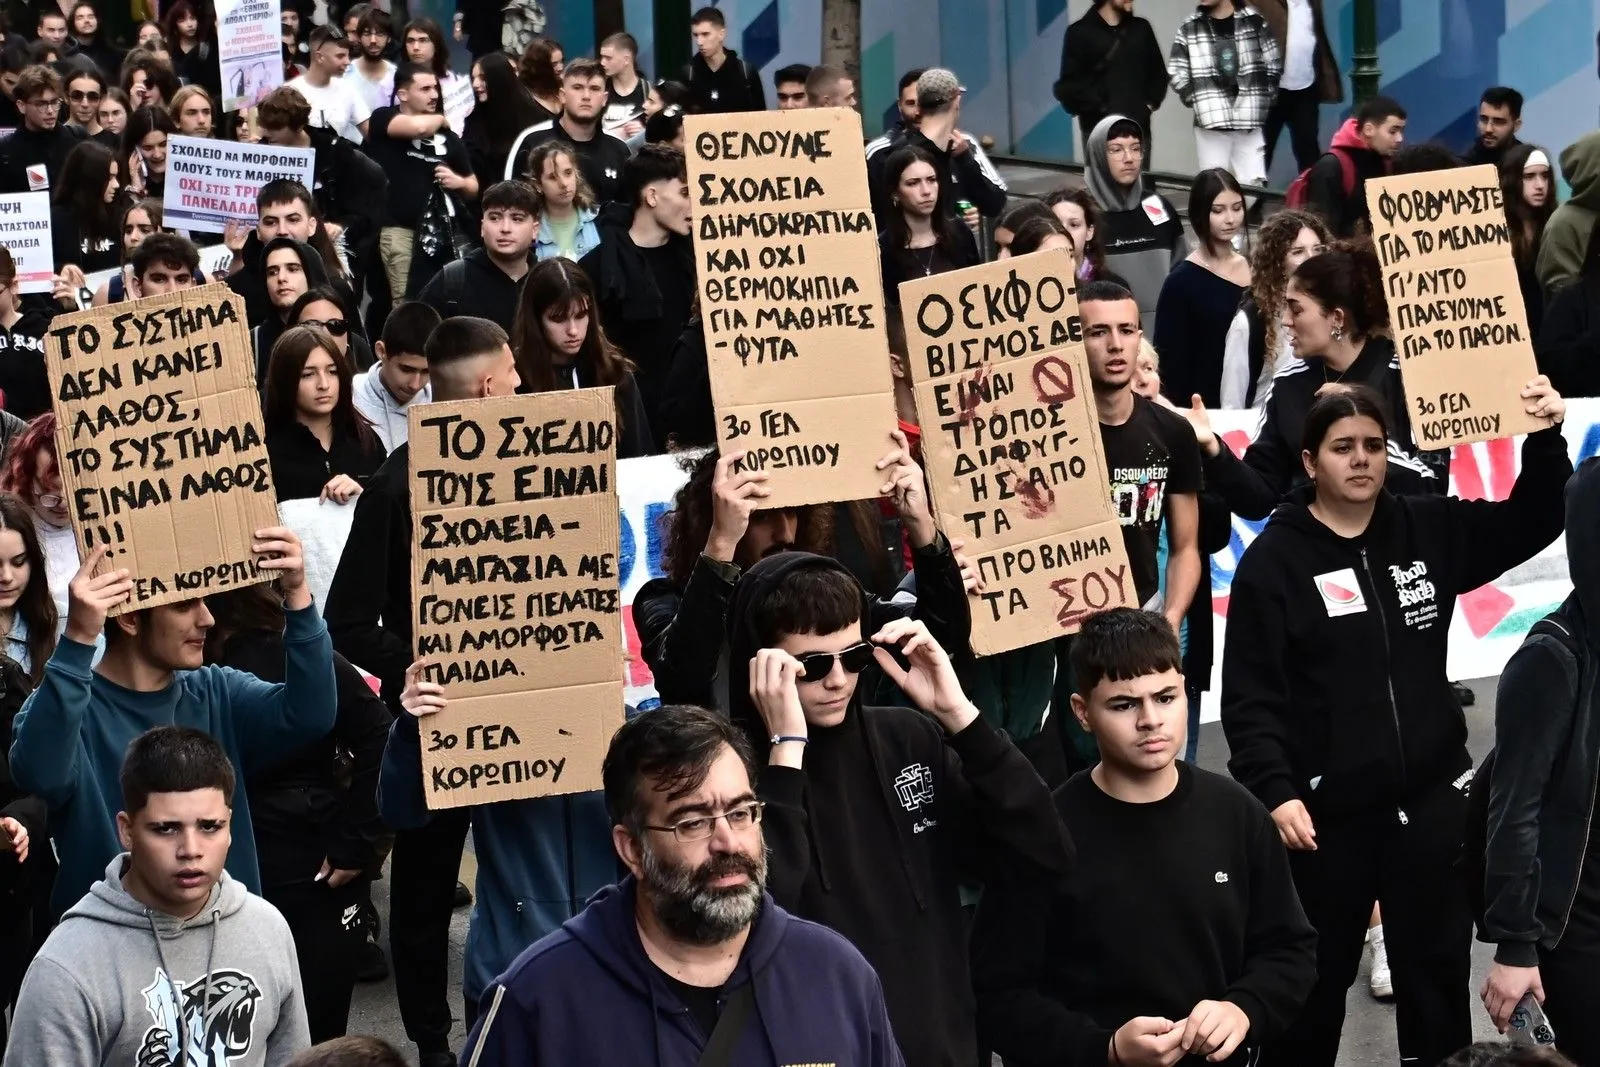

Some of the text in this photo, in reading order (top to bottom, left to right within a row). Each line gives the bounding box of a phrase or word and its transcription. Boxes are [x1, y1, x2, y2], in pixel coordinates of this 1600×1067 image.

[171, 144, 308, 168] ΣΧΟΛΕΙΟ ΝΑ ΜΟΡΦΩΝΕΙ
[696, 129, 832, 162] ΘΕΛΟΥΜΕ
[173, 161, 212, 176] ΟΛΟΥΣ
[215, 167, 242, 179] ΤΟΥΣ
[179, 177, 202, 191] ΟΧΙ
[205, 183, 231, 196] ΣΤΙΣ
[698, 173, 825, 206] ΣΧΟΛΕΙΑ
[699, 210, 873, 241] ΔΗΜΟΚΡΑΤΙΚΑ
[706, 244, 806, 274] ΚΑΙ ΟΧΙ
[1379, 222, 1513, 267] ΓΙΑ ΤΟ ΜΕΛΛΟΝ
[705, 275, 860, 302] ΘΕΡΜΟΚΗΠΙΑ
[50, 300, 240, 361] ΤΟ ΣΥΣΤΗΜΑ
[709, 303, 875, 333] ΓΙΑ ΜΑΘΗΤΕΣ
[1396, 295, 1507, 331] ΠΑΛΕΥΟΥΜΕ
[926, 325, 1045, 379] ΒΙΣΜΟΣ
[1402, 322, 1527, 360] ΓΙΑ ΤΟ ΠΑΡΟΝ.
[58, 342, 223, 402] ΔΕΝ ΚΑΝΕΙ
[933, 371, 1015, 417] ΕΙΝΑΙ
[1440, 392, 1472, 416] ΓΕΛ
[420, 414, 613, 461] ΤΟ ΣΧΕΔΙΟ
[759, 409, 801, 438] ΓΕΛ
[941, 402, 1066, 450] ΤΡΟΠΟΣ
[1421, 413, 1502, 442] ΚΟΡΩΠΙΟΥ
[66, 421, 263, 478] ΤΟ ΣΥΣΤΗΜΑ
[76, 457, 271, 523] ΕΙΝΑΙ ΛΑΘΟΣ
[417, 463, 609, 506] ΤΟΥΣ ΕΙΝΑΙ
[970, 455, 1086, 502] ΗΣ ΑΠΟ
[1114, 467, 1169, 481] DSQUARED2
[963, 510, 1012, 540] ΤΑ
[576, 553, 616, 581] ΜΕ
[977, 536, 1112, 583] ΠΡΟΒΛΗΜΑ
[419, 587, 619, 626] ΓΟΝΕΙΣ ΠΕΛΑΤΕΣ
[981, 564, 1128, 622] ΤΑ ΣΟΥ
[418, 620, 604, 658] ΚΑΙ ΑΜΟΡΦΩΤΑ
[465, 724, 521, 752] ΓΕΛ
[431, 756, 567, 793] ΚΟΡΩΠΙΟΥ
